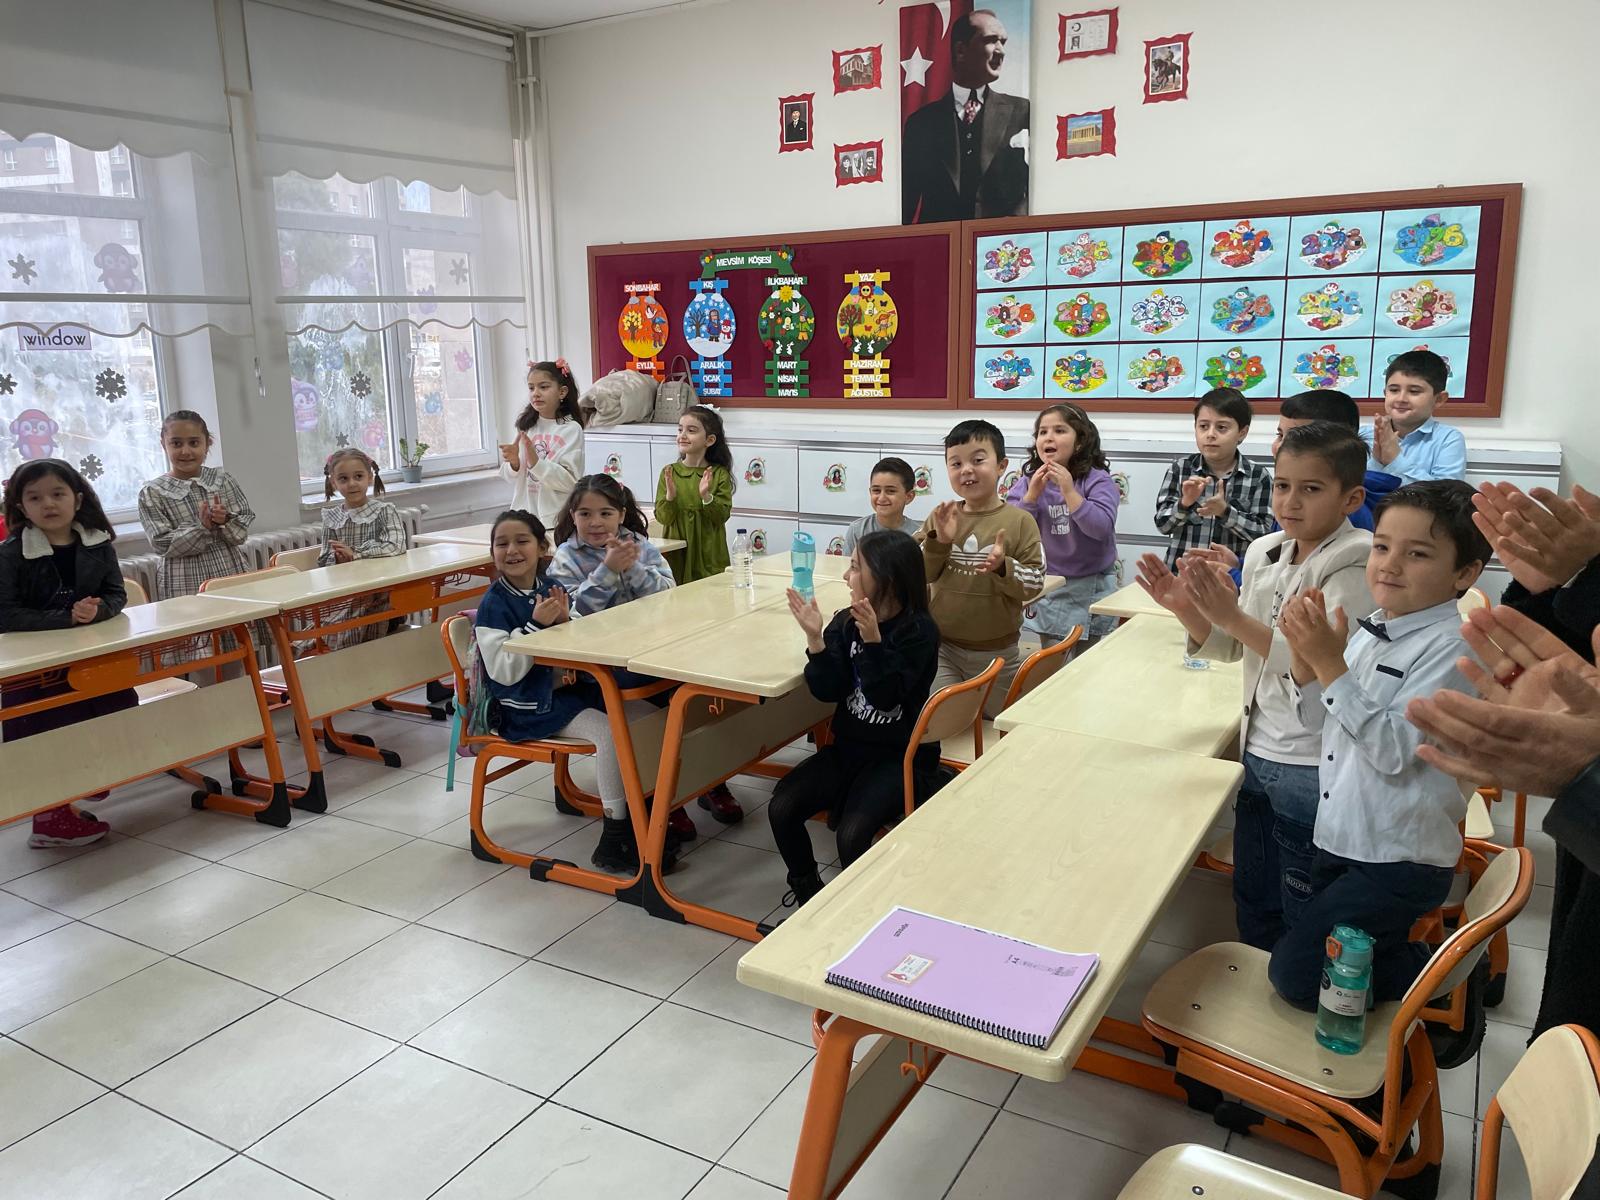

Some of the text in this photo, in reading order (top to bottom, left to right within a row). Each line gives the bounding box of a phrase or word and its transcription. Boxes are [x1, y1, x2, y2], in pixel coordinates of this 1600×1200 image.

[716, 255, 772, 267] MEVSİM KÖŞESİ
[767, 277, 804, 285] İLKBAHAR
[859, 273, 875, 282] YAZ
[624, 284, 659, 292] SONBAHAR
[703, 281, 714, 289] KIŞ
[23, 329, 86, 346] window
[636, 361, 656, 369] EYLÜL
[700, 361, 725, 369] ARALIK
[777, 361, 798, 369] MART
[777, 374, 798, 383] NİSAN
[851, 374, 883, 382] TEMMUZ
[703, 388, 722, 396] ŞUBAT
[777, 388, 799, 397] MAYIS
